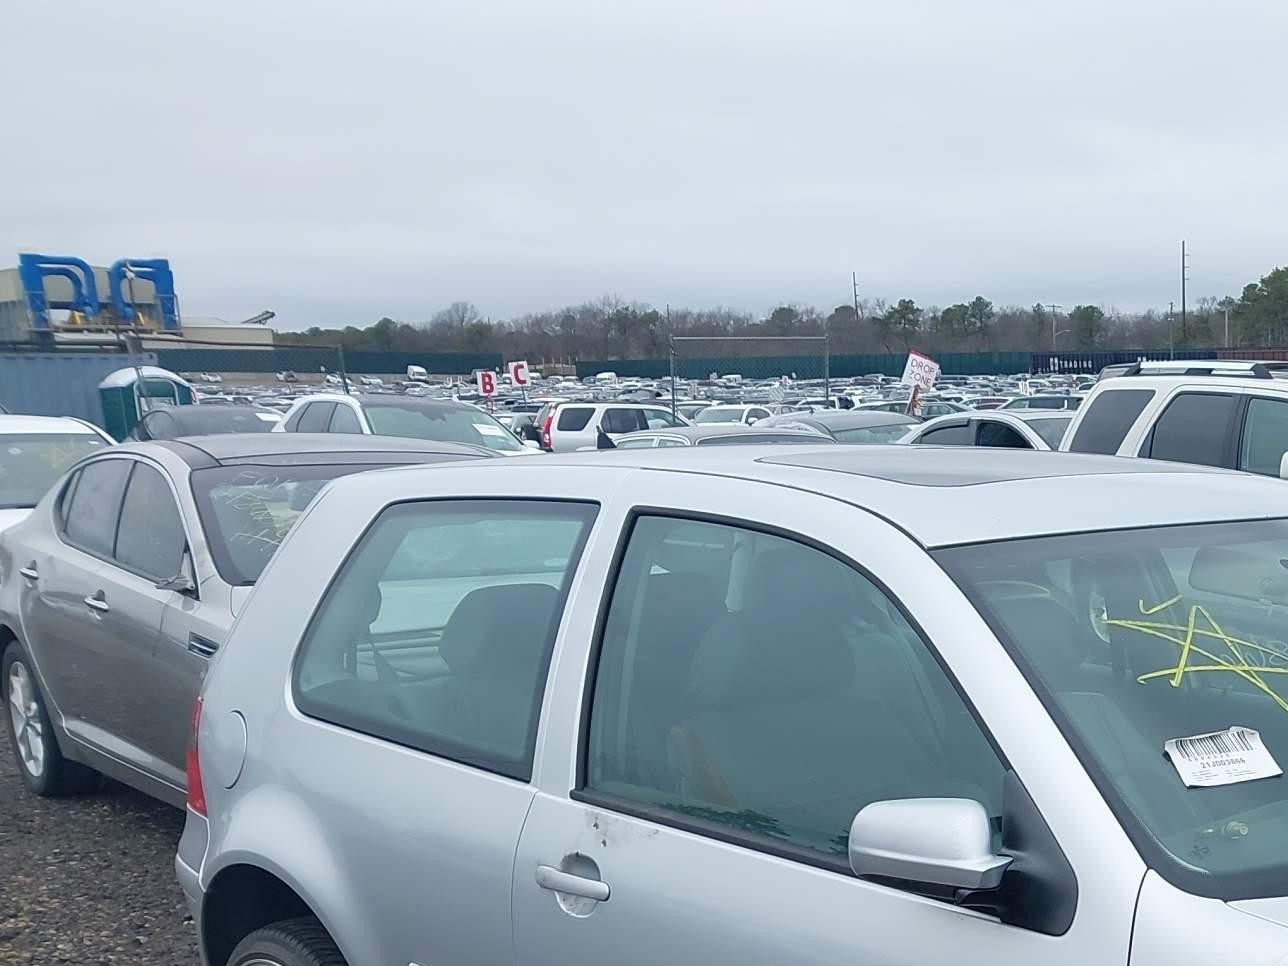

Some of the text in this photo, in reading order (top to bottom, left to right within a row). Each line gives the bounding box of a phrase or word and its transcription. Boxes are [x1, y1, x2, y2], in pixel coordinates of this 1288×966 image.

[514, 364, 527, 385] C
[911, 359, 934, 375] DROP
[481, 373, 494, 393] B
[909, 370, 932, 386] ZONE
